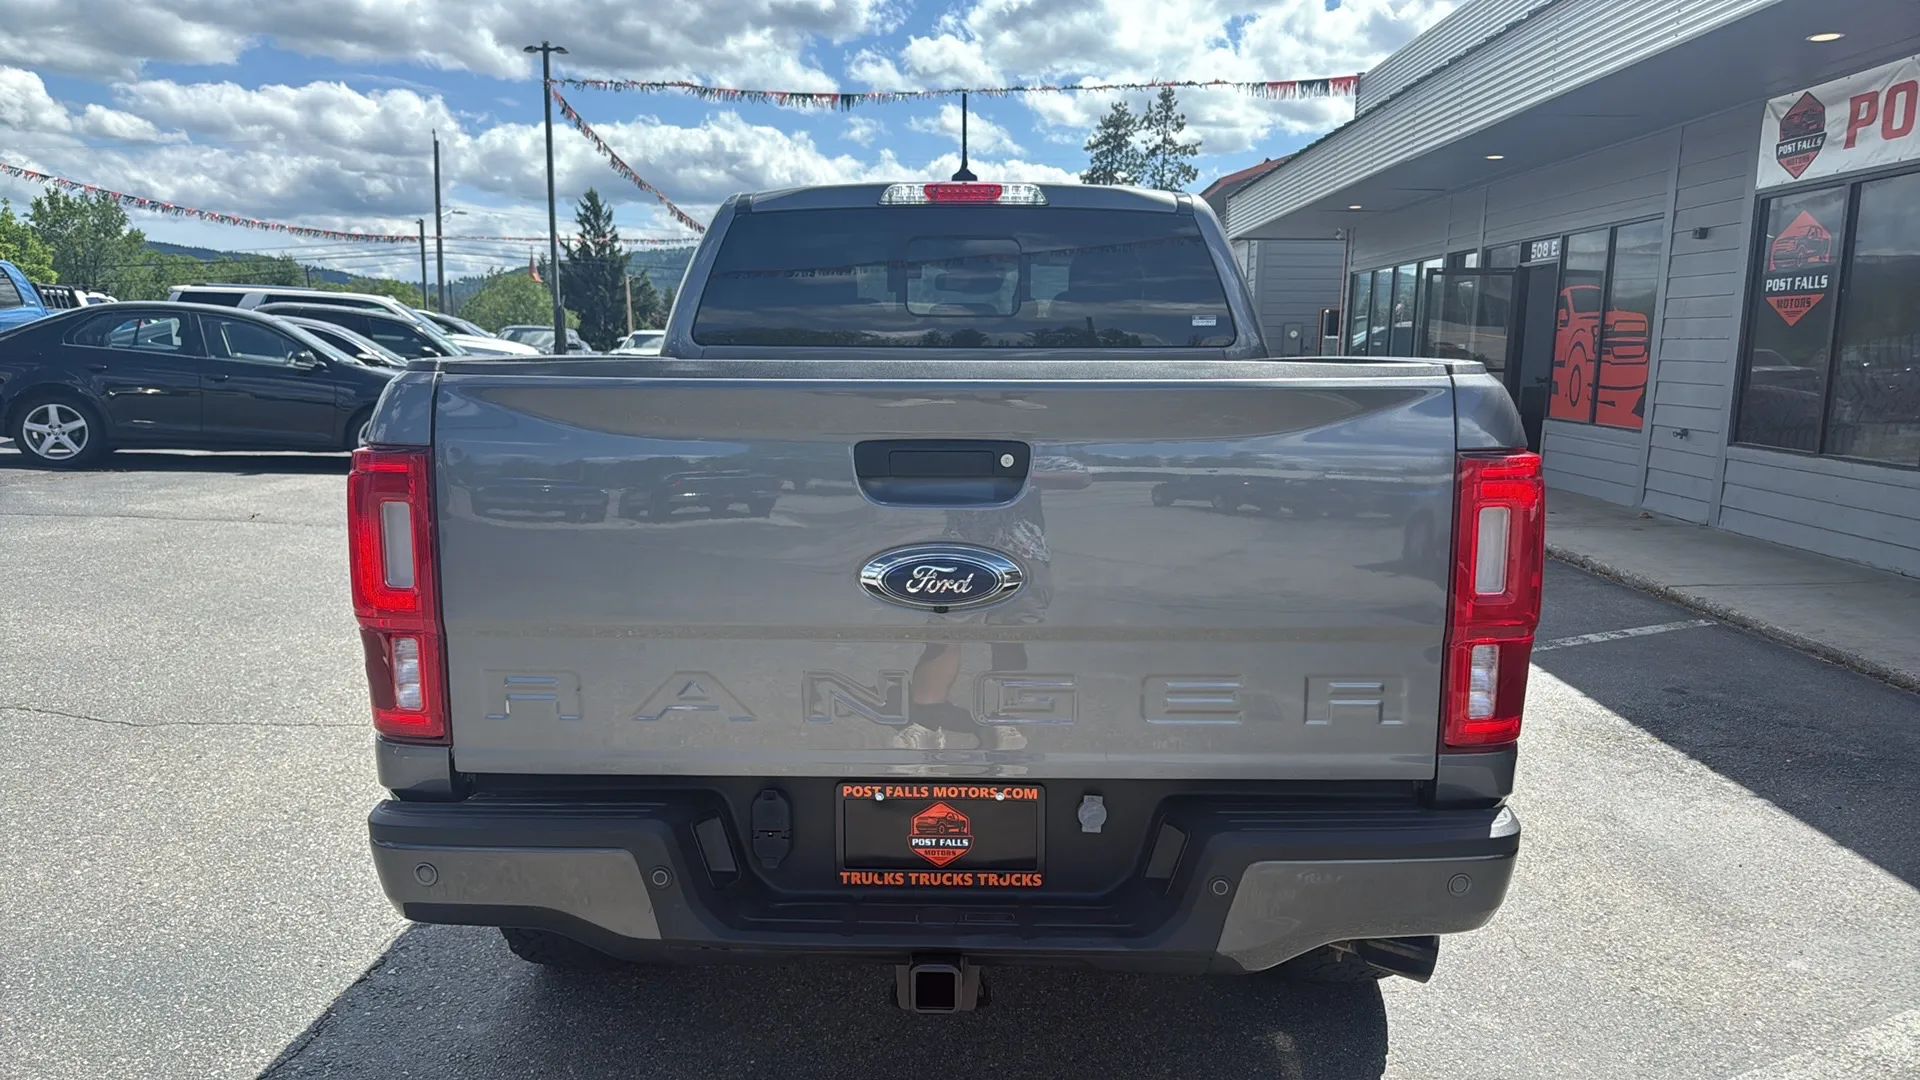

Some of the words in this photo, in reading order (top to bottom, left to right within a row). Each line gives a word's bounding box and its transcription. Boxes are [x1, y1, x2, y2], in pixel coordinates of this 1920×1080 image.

[1778, 142, 1796, 156] POST
[1797, 136, 1824, 151] FALLS
[1531, 242, 1549, 259] 508
[1765, 277, 1793, 292] POST
[1794, 274, 1829, 290] FALLS
[905, 565, 975, 594] Ford
[483, 668, 1406, 726] RANGER
[843, 785, 882, 797] POST
[885, 786, 929, 798] FALLS
[933, 786, 1038, 800] MOTORSCOM
[912, 838, 937, 846] POST
[939, 838, 969, 847] FALLS
[840, 872, 904, 885] TRUCKS
[908, 873, 973, 886] TRUCKS
